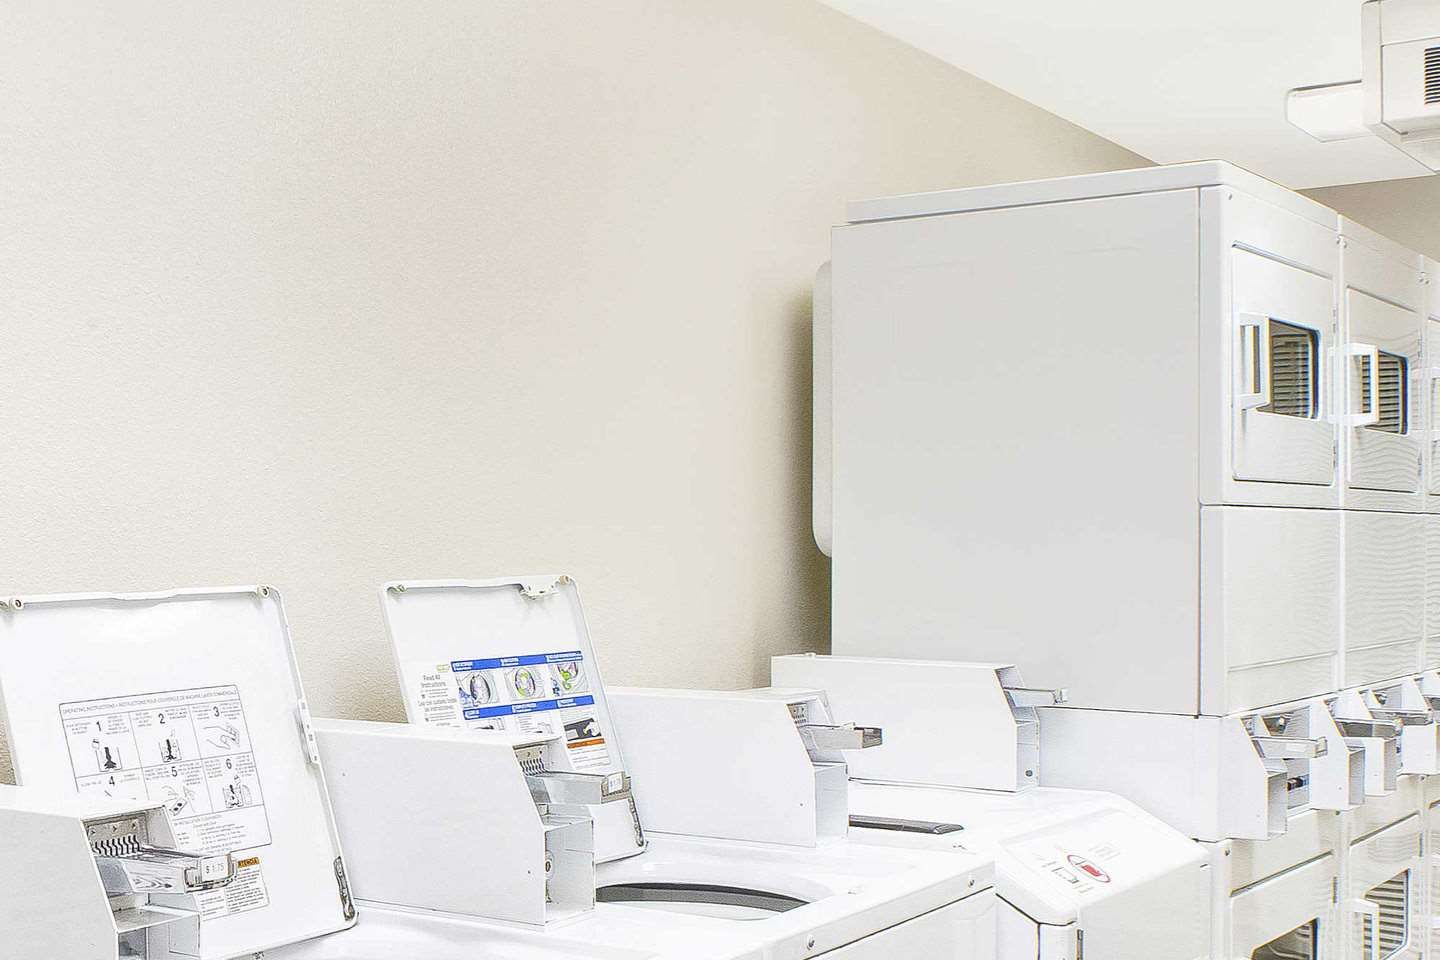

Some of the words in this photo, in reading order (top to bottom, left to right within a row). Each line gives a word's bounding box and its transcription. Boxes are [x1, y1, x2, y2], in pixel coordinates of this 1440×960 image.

[212, 706, 220, 717] 3
[157, 713, 165, 724] 2
[95, 721, 101, 731] 1
[225, 758, 232, 769] 6
[170, 766, 177, 777] 5
[107, 776, 115, 786] 4
